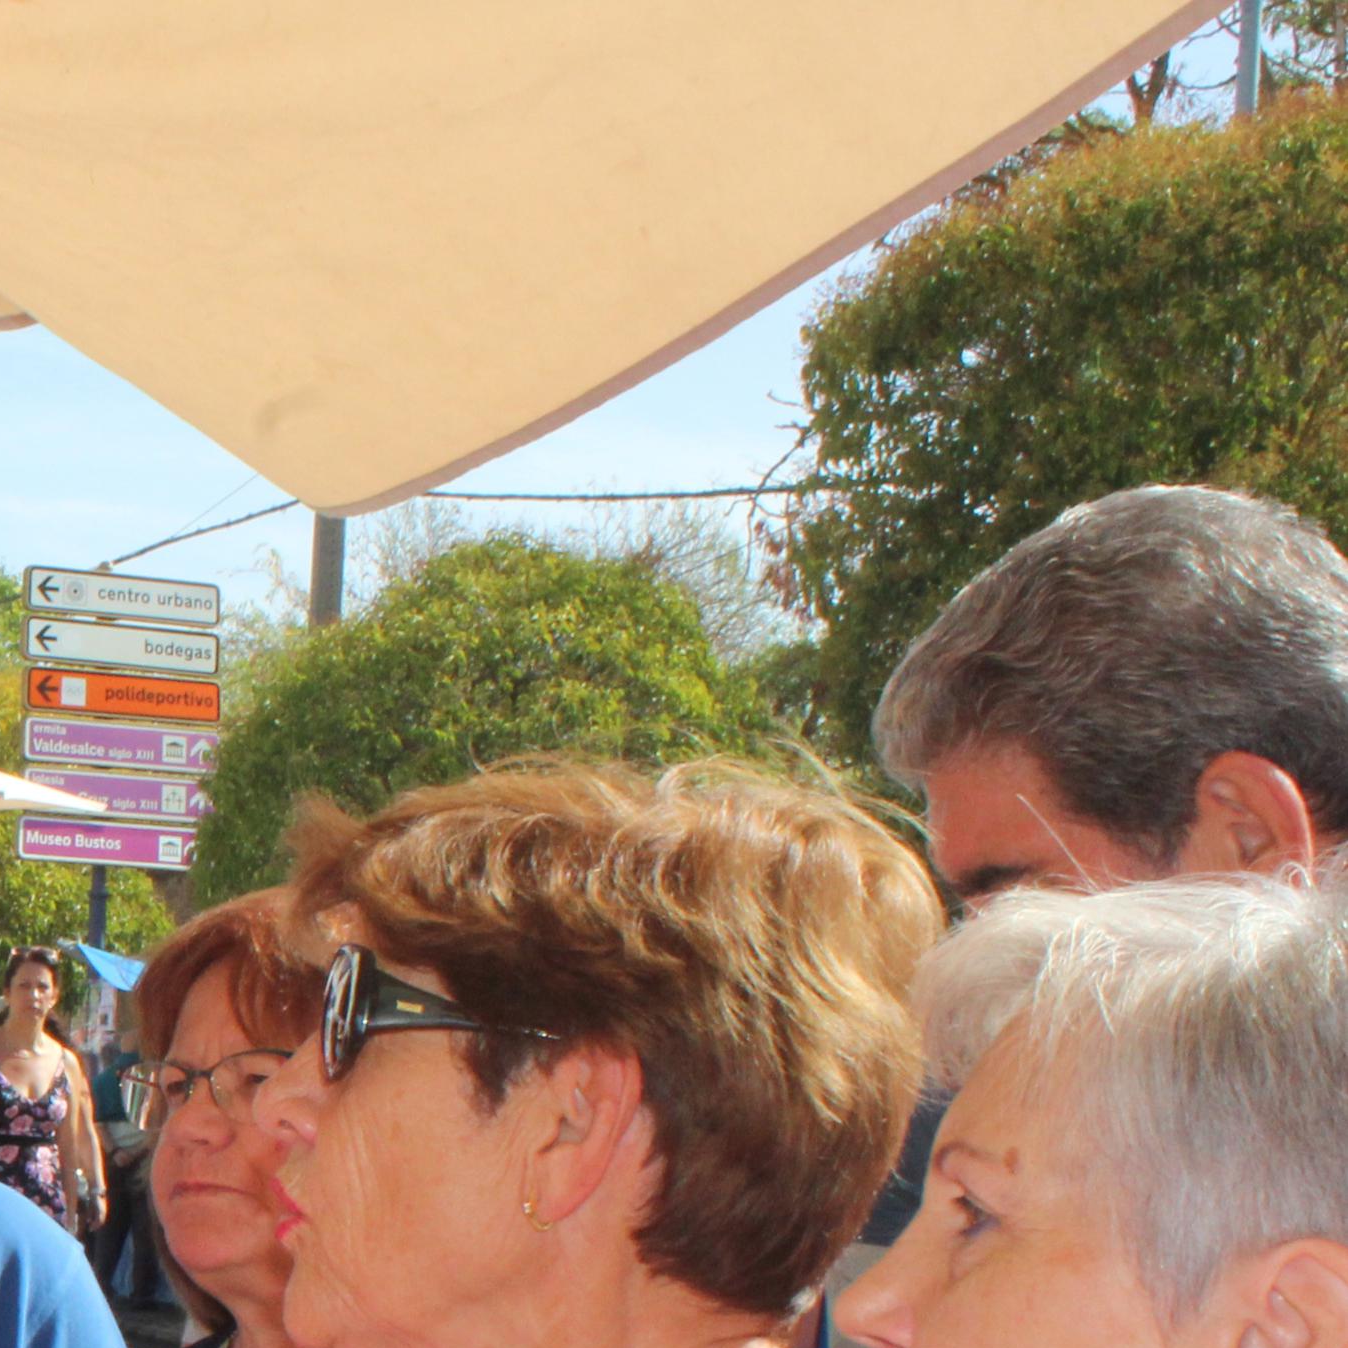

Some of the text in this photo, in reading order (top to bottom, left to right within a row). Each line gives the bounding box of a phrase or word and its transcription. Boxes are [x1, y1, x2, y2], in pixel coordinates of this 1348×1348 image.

[97, 586, 213, 611] centro urbano
[144, 638, 212, 661] bodegas
[105, 685, 214, 708] polideportivo
[33, 724, 67, 735] ermita
[33, 737, 155, 760] Valdesalce siglo XIII
[32, 773, 65, 786] iglesia
[112, 798, 137, 811] siglo
[25, 829, 122, 850] Museo Bustos
